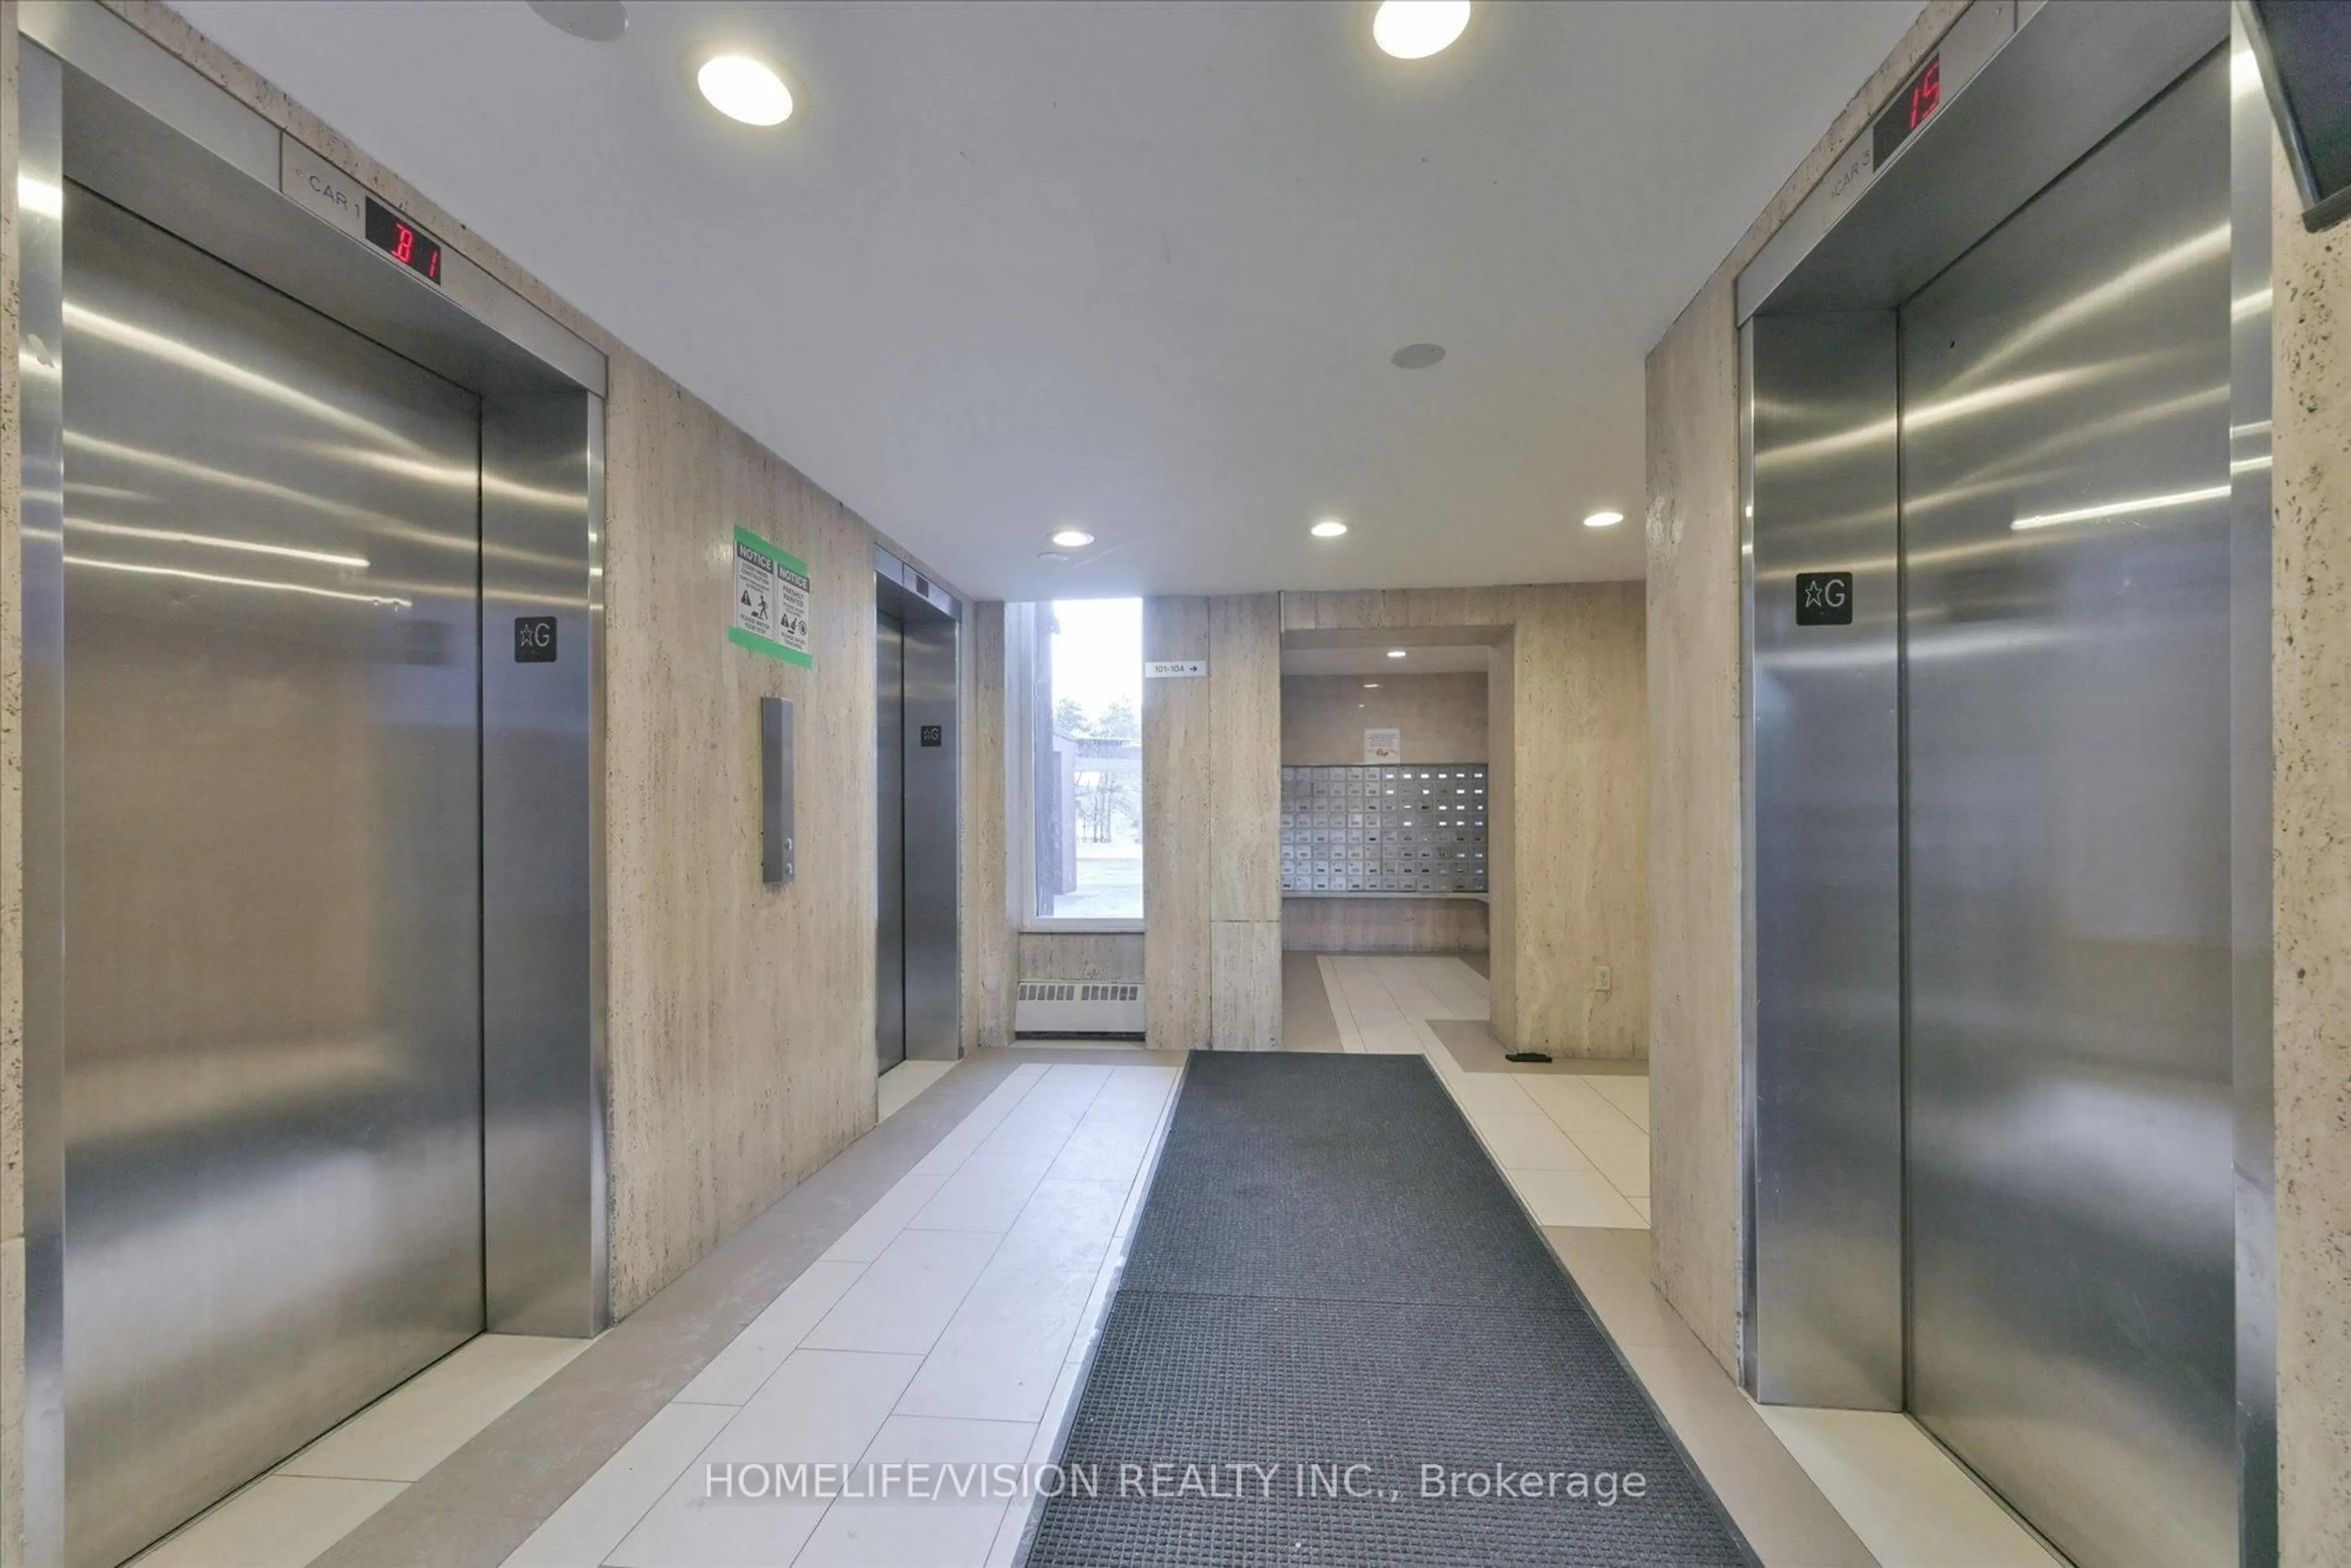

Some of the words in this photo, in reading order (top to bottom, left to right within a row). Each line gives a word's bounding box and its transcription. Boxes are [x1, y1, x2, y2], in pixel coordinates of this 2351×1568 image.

[1909, 61, 1940, 130] 15
[1834, 163, 1861, 197] CAR
[309, 174, 348, 211] CAR
[354, 203, 361, 219] 1
[740, 544, 771, 571] NOTICE
[779, 566, 808, 589] NOTICE
[1824, 578, 1845, 607] G
[534, 622, 550, 647] G
